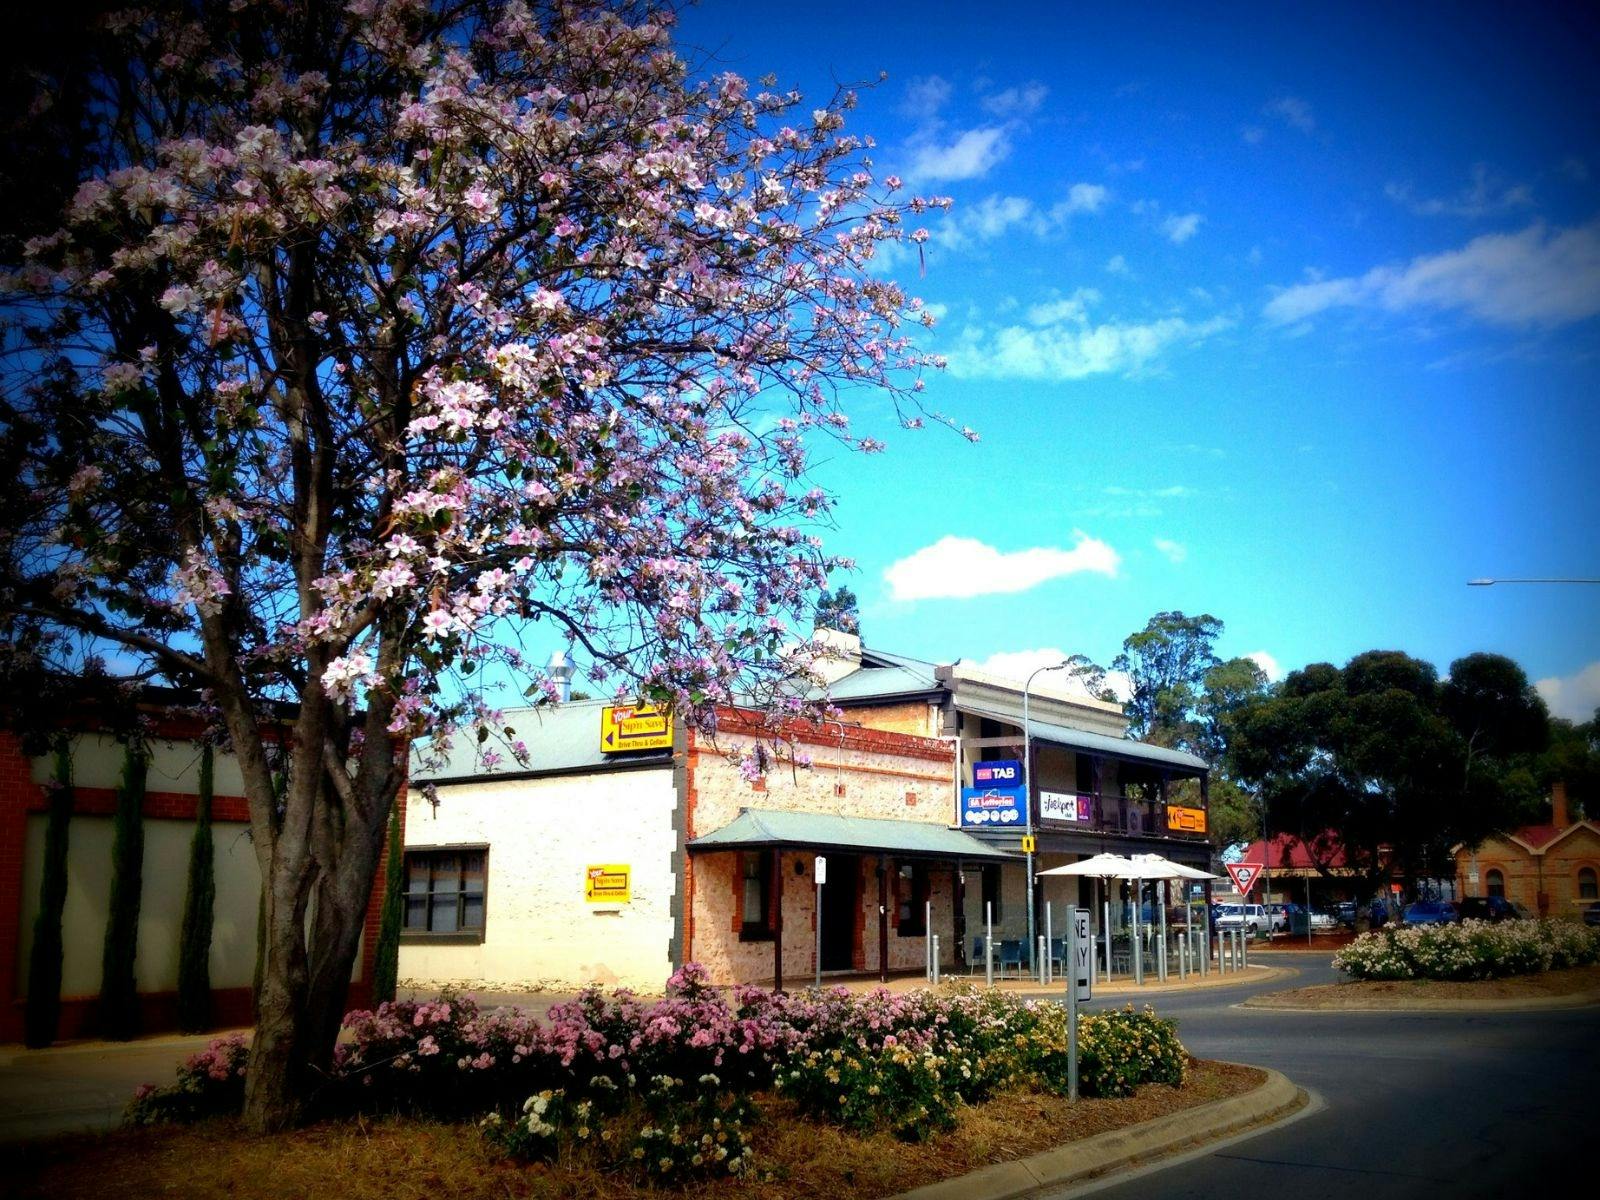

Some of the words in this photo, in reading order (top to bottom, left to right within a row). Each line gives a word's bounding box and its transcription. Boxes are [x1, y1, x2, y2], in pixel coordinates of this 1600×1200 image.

[645, 719, 664, 728] Save
[992, 767, 1014, 779] TAB
[970, 798, 980, 806] SA
[981, 797, 1013, 807] Lotteries
[1075, 919, 1086, 939] NE
